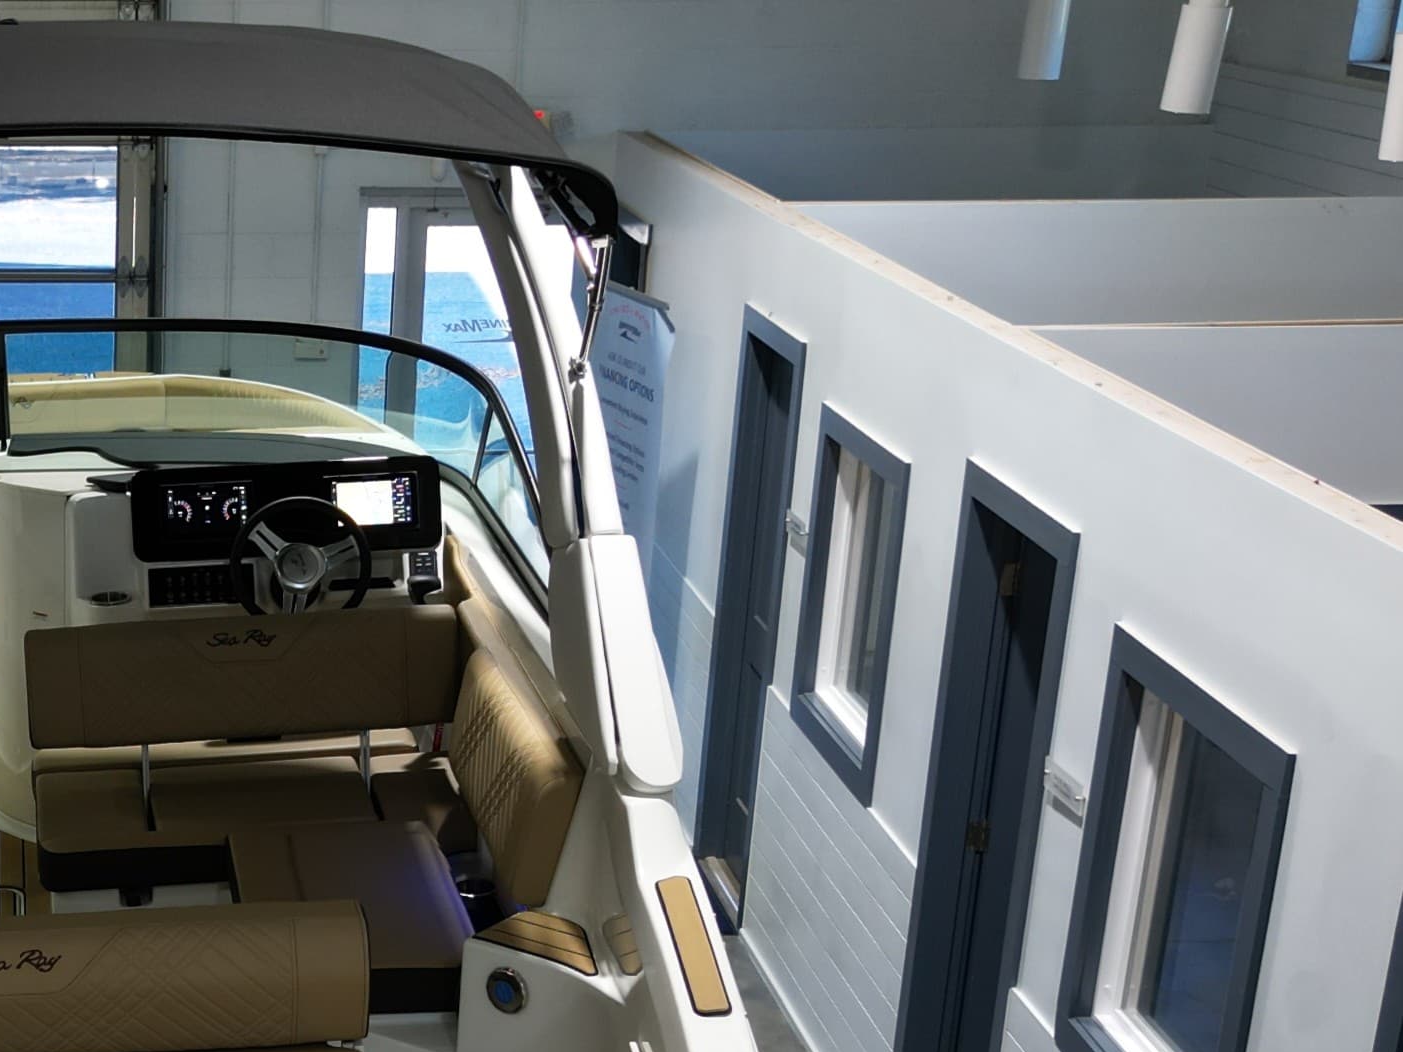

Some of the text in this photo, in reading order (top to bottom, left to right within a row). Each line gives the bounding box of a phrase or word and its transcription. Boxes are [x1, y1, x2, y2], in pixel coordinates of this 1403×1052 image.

[206, 629, 277, 647] Sea Ray
[15, 949, 62, 973] Ray
